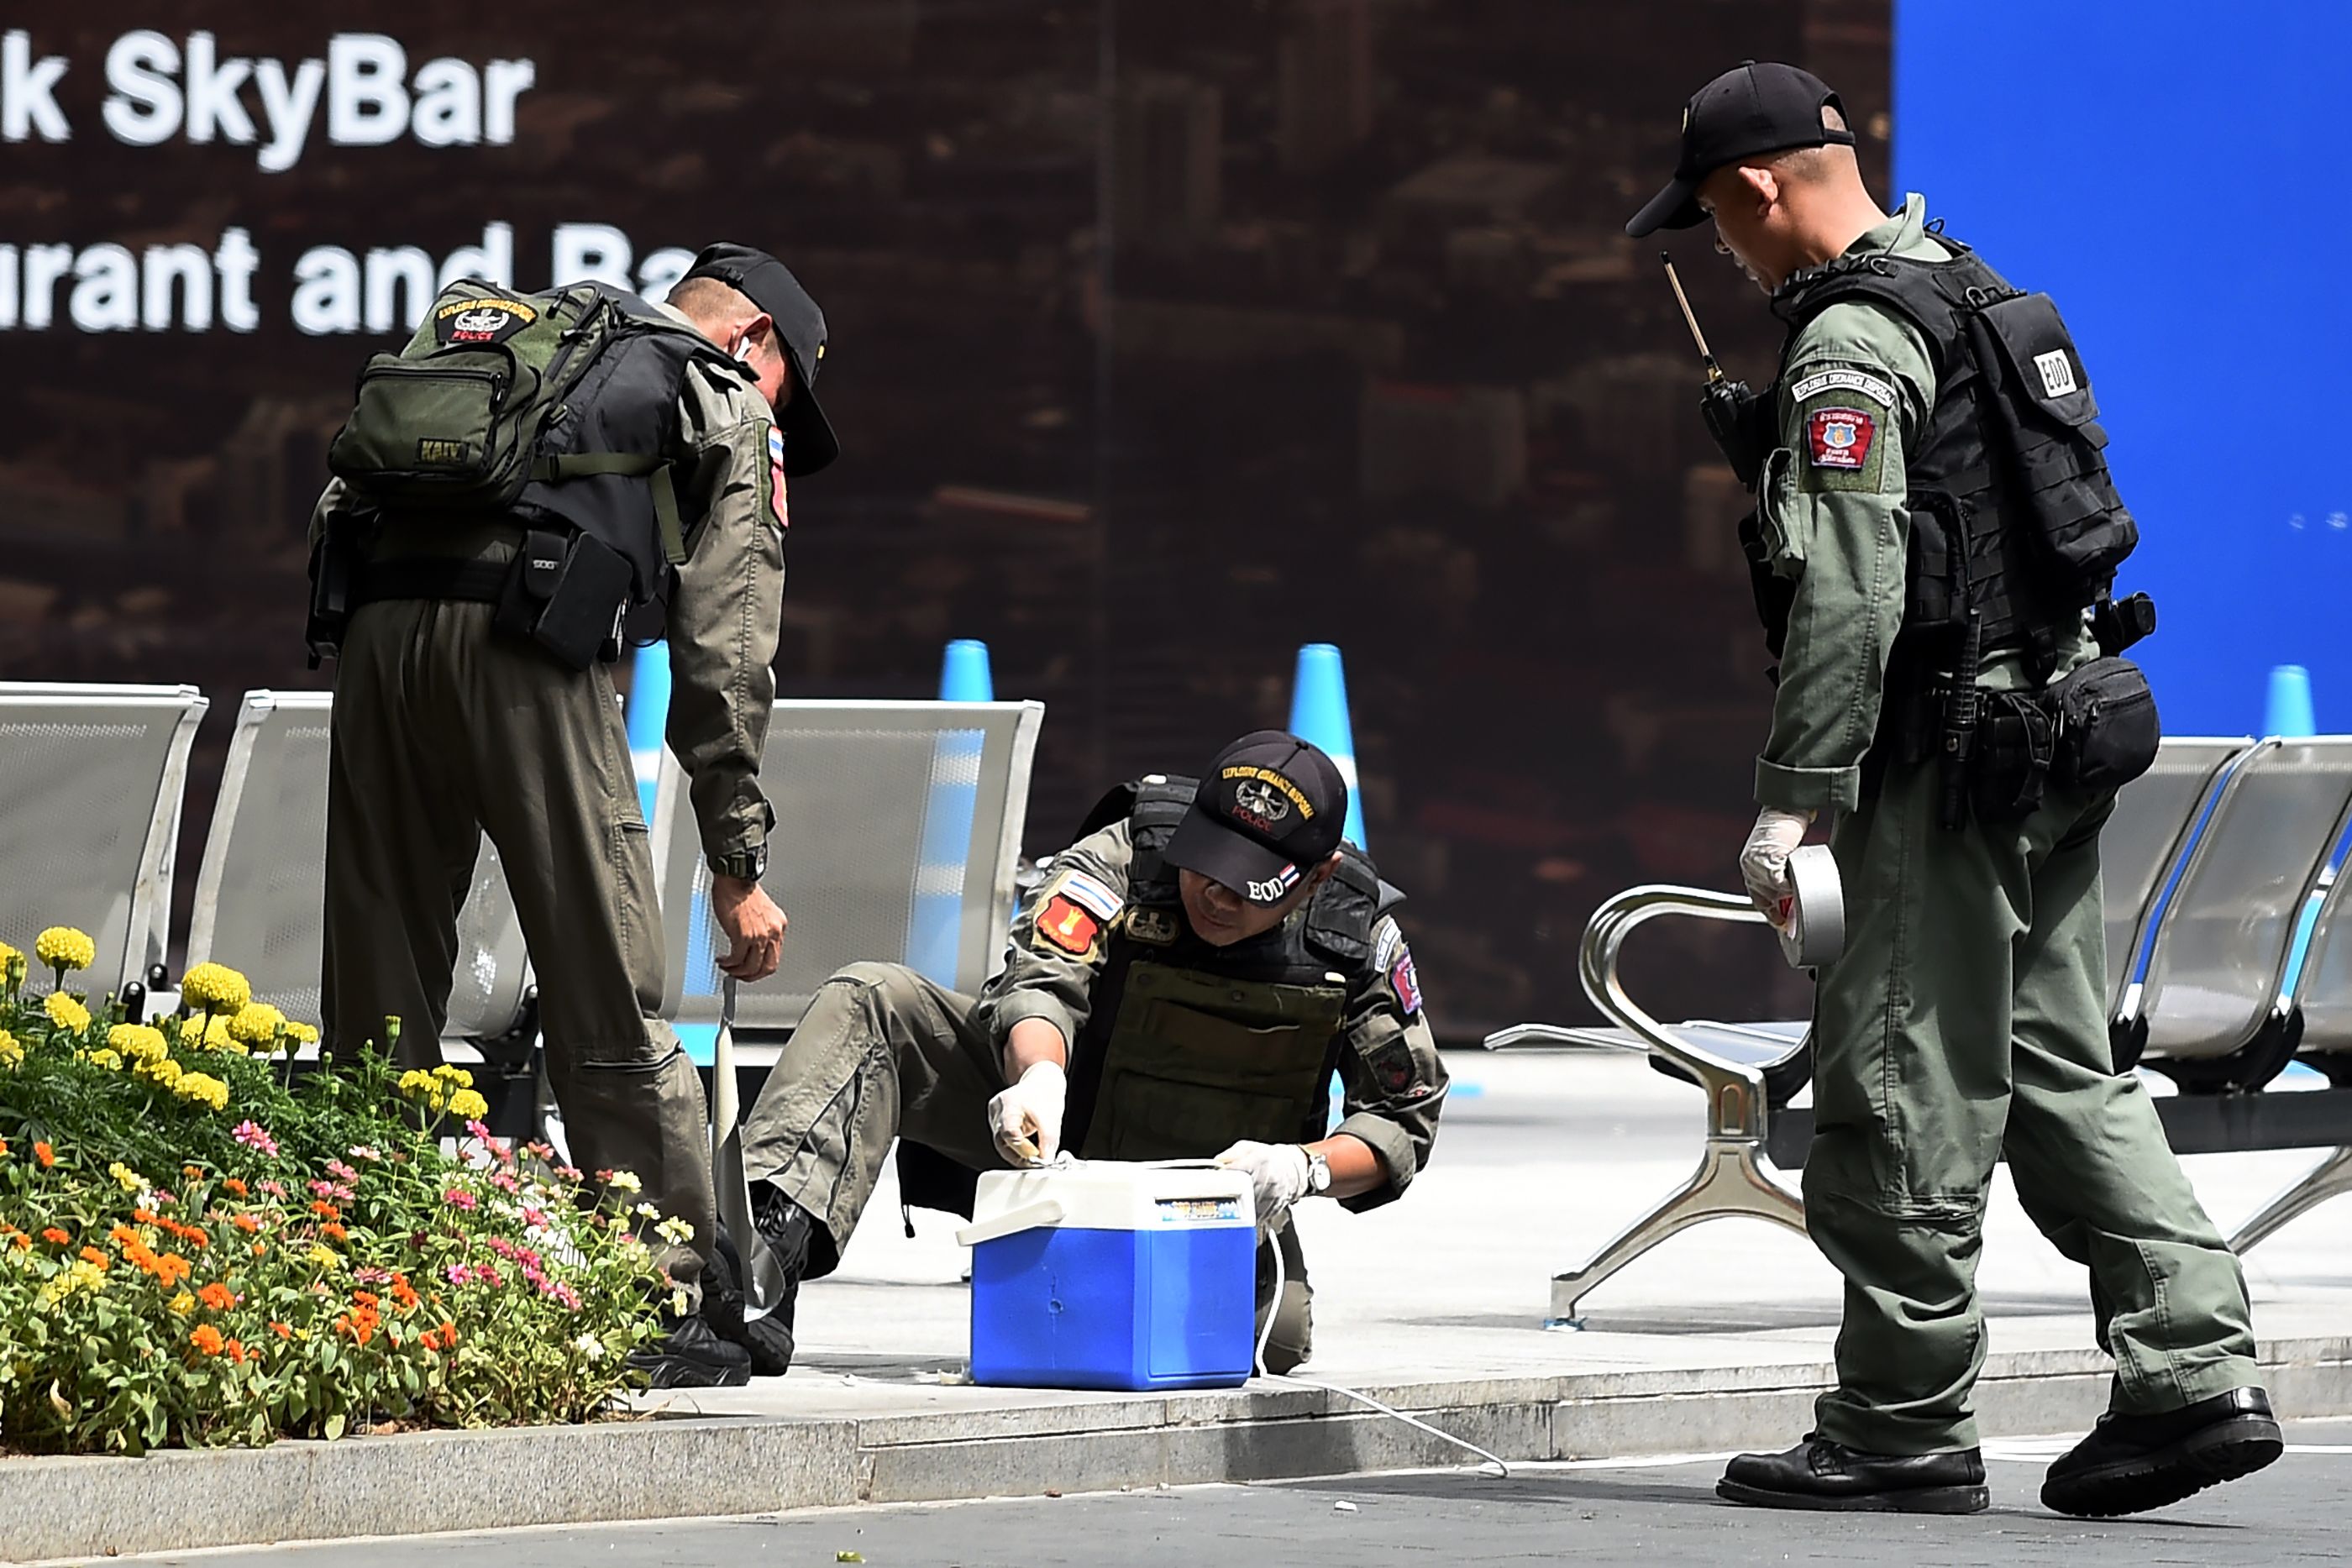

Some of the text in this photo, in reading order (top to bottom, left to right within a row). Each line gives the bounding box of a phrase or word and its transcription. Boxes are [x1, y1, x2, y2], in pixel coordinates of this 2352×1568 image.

[2, 29, 536, 172] k SkyBar
[291, 220, 515, 335] and
[2040, 356, 2070, 391] EOD
[1231, 805, 1273, 832] POLICE
[1247, 877, 1284, 902] EOD
